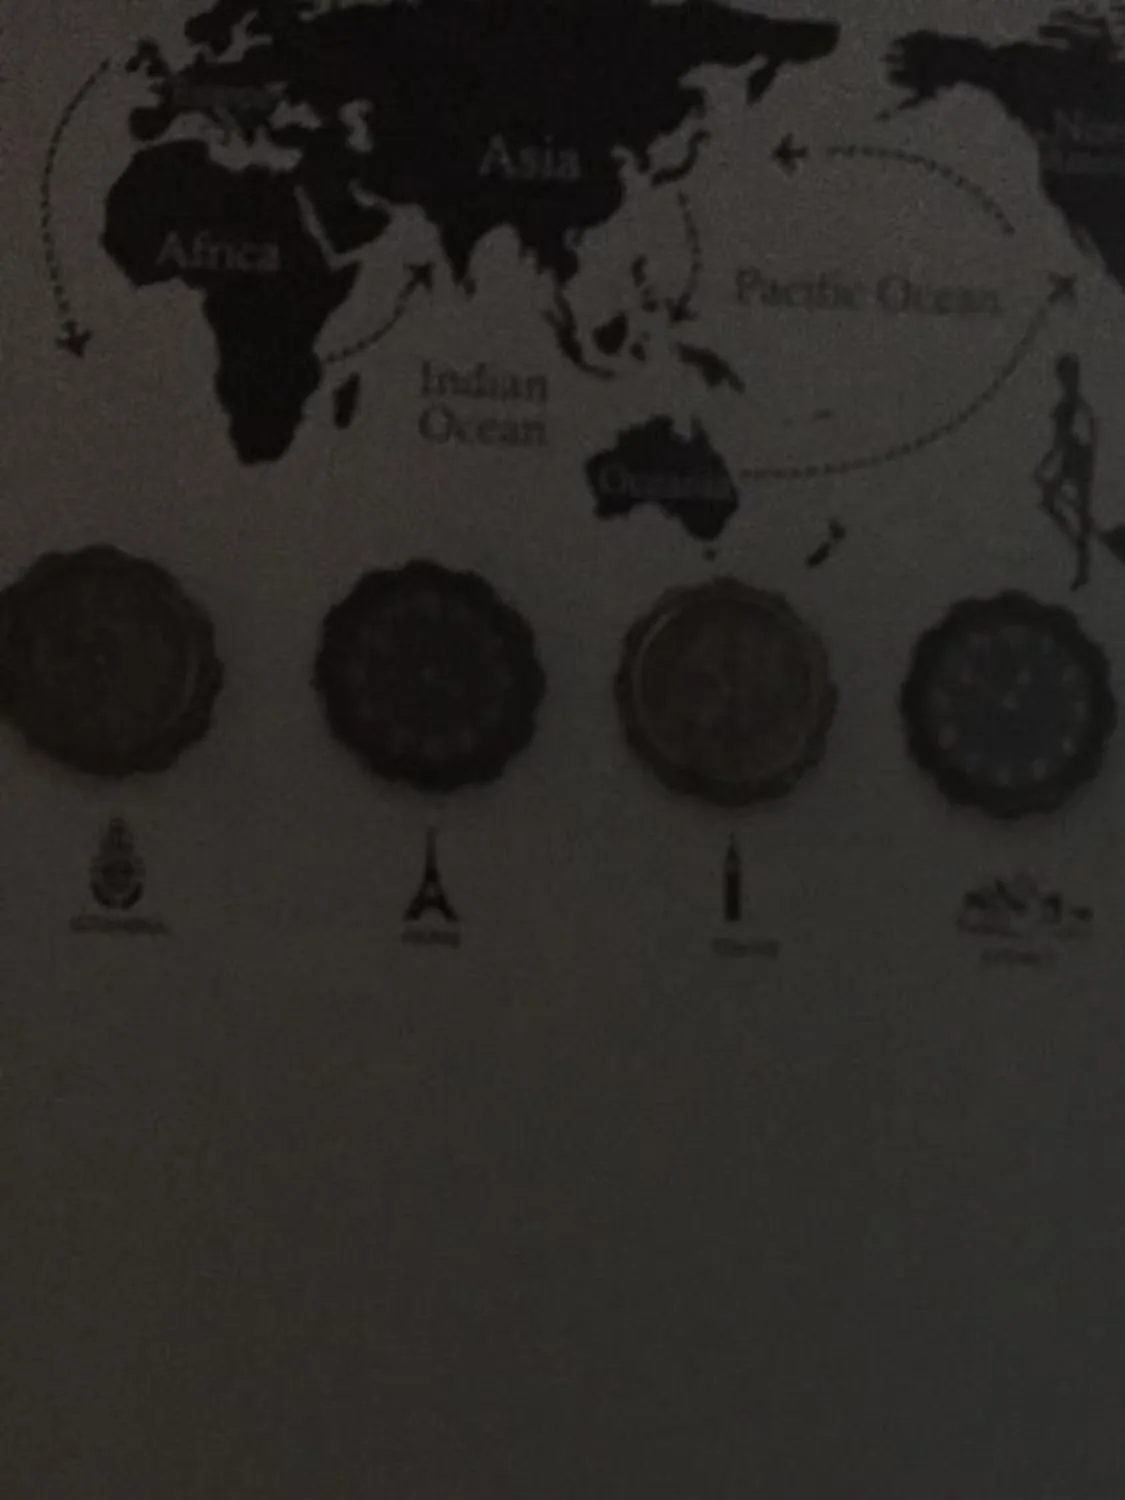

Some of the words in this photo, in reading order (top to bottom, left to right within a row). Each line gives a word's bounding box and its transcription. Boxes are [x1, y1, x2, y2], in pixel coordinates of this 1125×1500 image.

[477, 133, 582, 181] Asia
[155, 230, 282, 272] Africa
[736, 266, 861, 308] Pacific
[876, 274, 1003, 314] Ocean
[421, 360, 548, 402] Indian
[419, 405, 548, 446] Ocean
